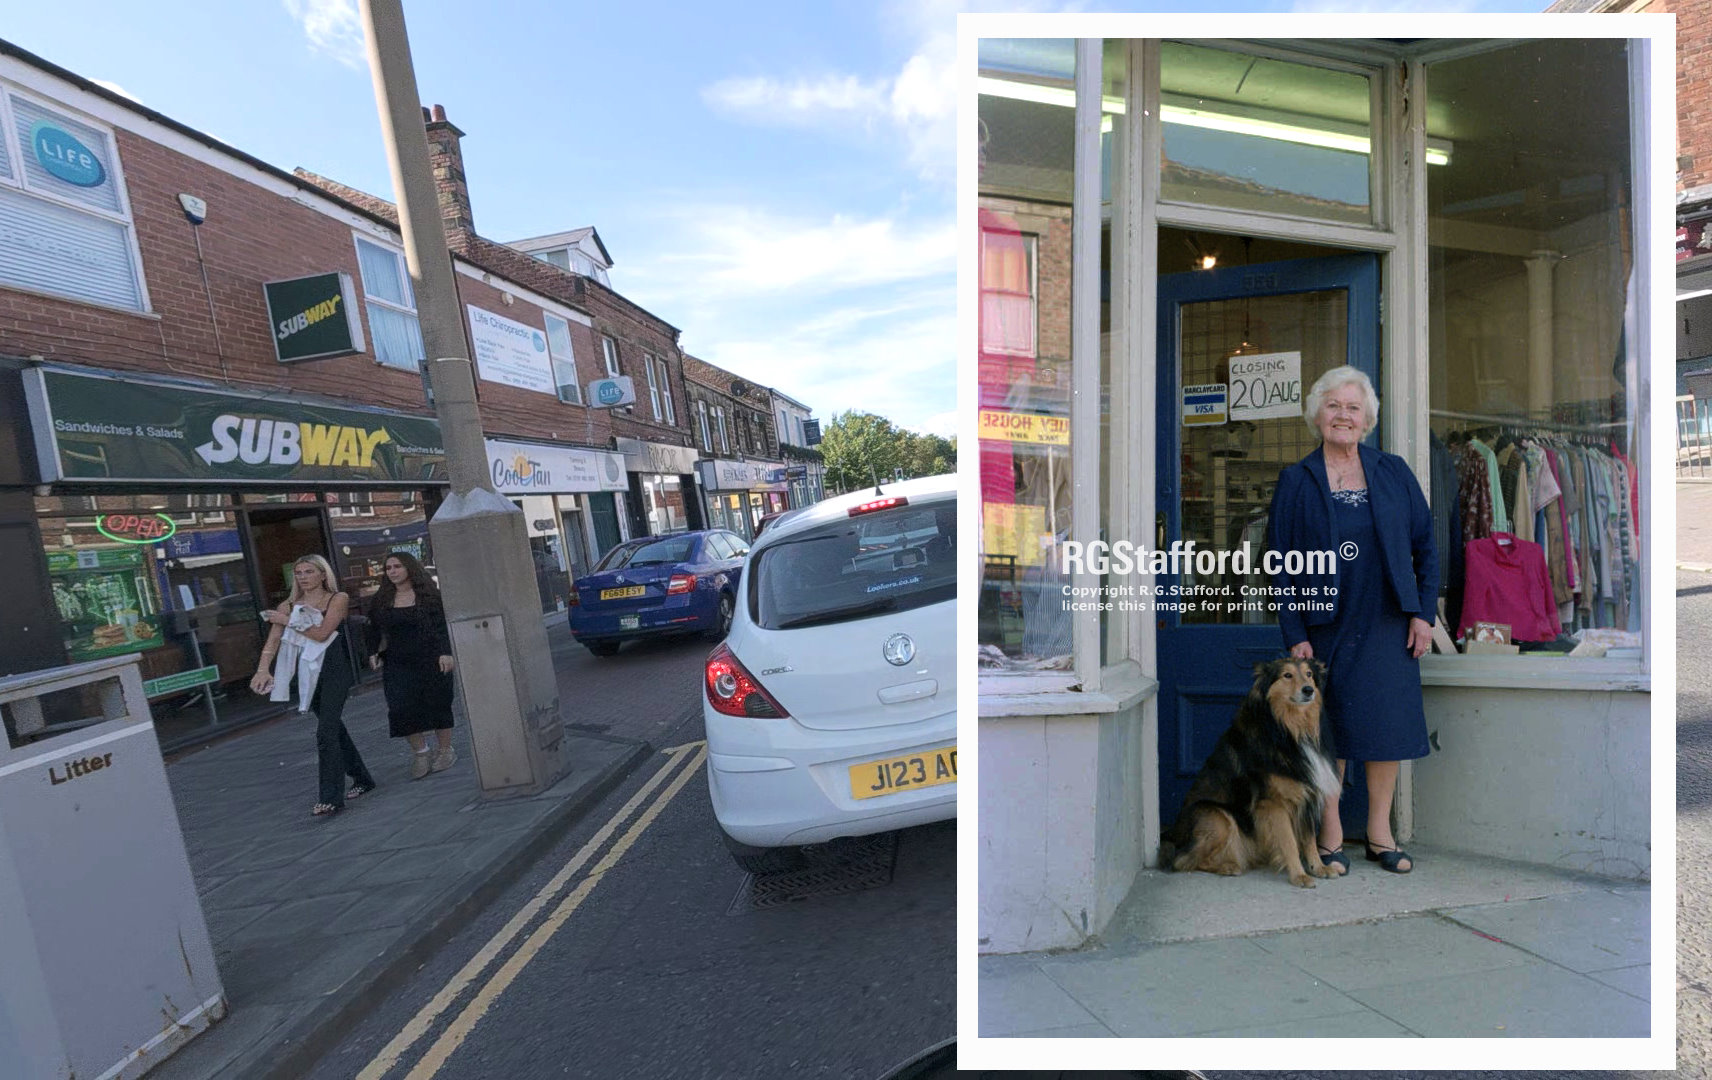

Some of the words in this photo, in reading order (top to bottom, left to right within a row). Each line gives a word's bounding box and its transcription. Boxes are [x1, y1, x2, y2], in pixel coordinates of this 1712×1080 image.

[278, 294, 341, 340] SUBWAY
[473, 311, 488, 325] Life
[1231, 360, 1285, 374] CLOSING
[1184, 385, 1225, 394] BARCLAYCARD
[1231, 378, 1267, 409] 20
[1268, 380, 1300, 403] AUG
[1195, 404, 1214, 413] VISA
[55, 419, 134, 435] Sandwiches
[135, 425, 144, 436] &
[146, 426, 184, 439] Salads
[195, 414, 391, 468] SUBWAY
[492, 458, 527, 487] Cool
[528, 460, 551, 487] Tan
[107, 514, 167, 537] OPEN
[604, 588, 625, 598] FG69
[626, 587, 642, 596] ESY
[48, 752, 112, 786] Litter
[870, 758, 927, 791] J123
